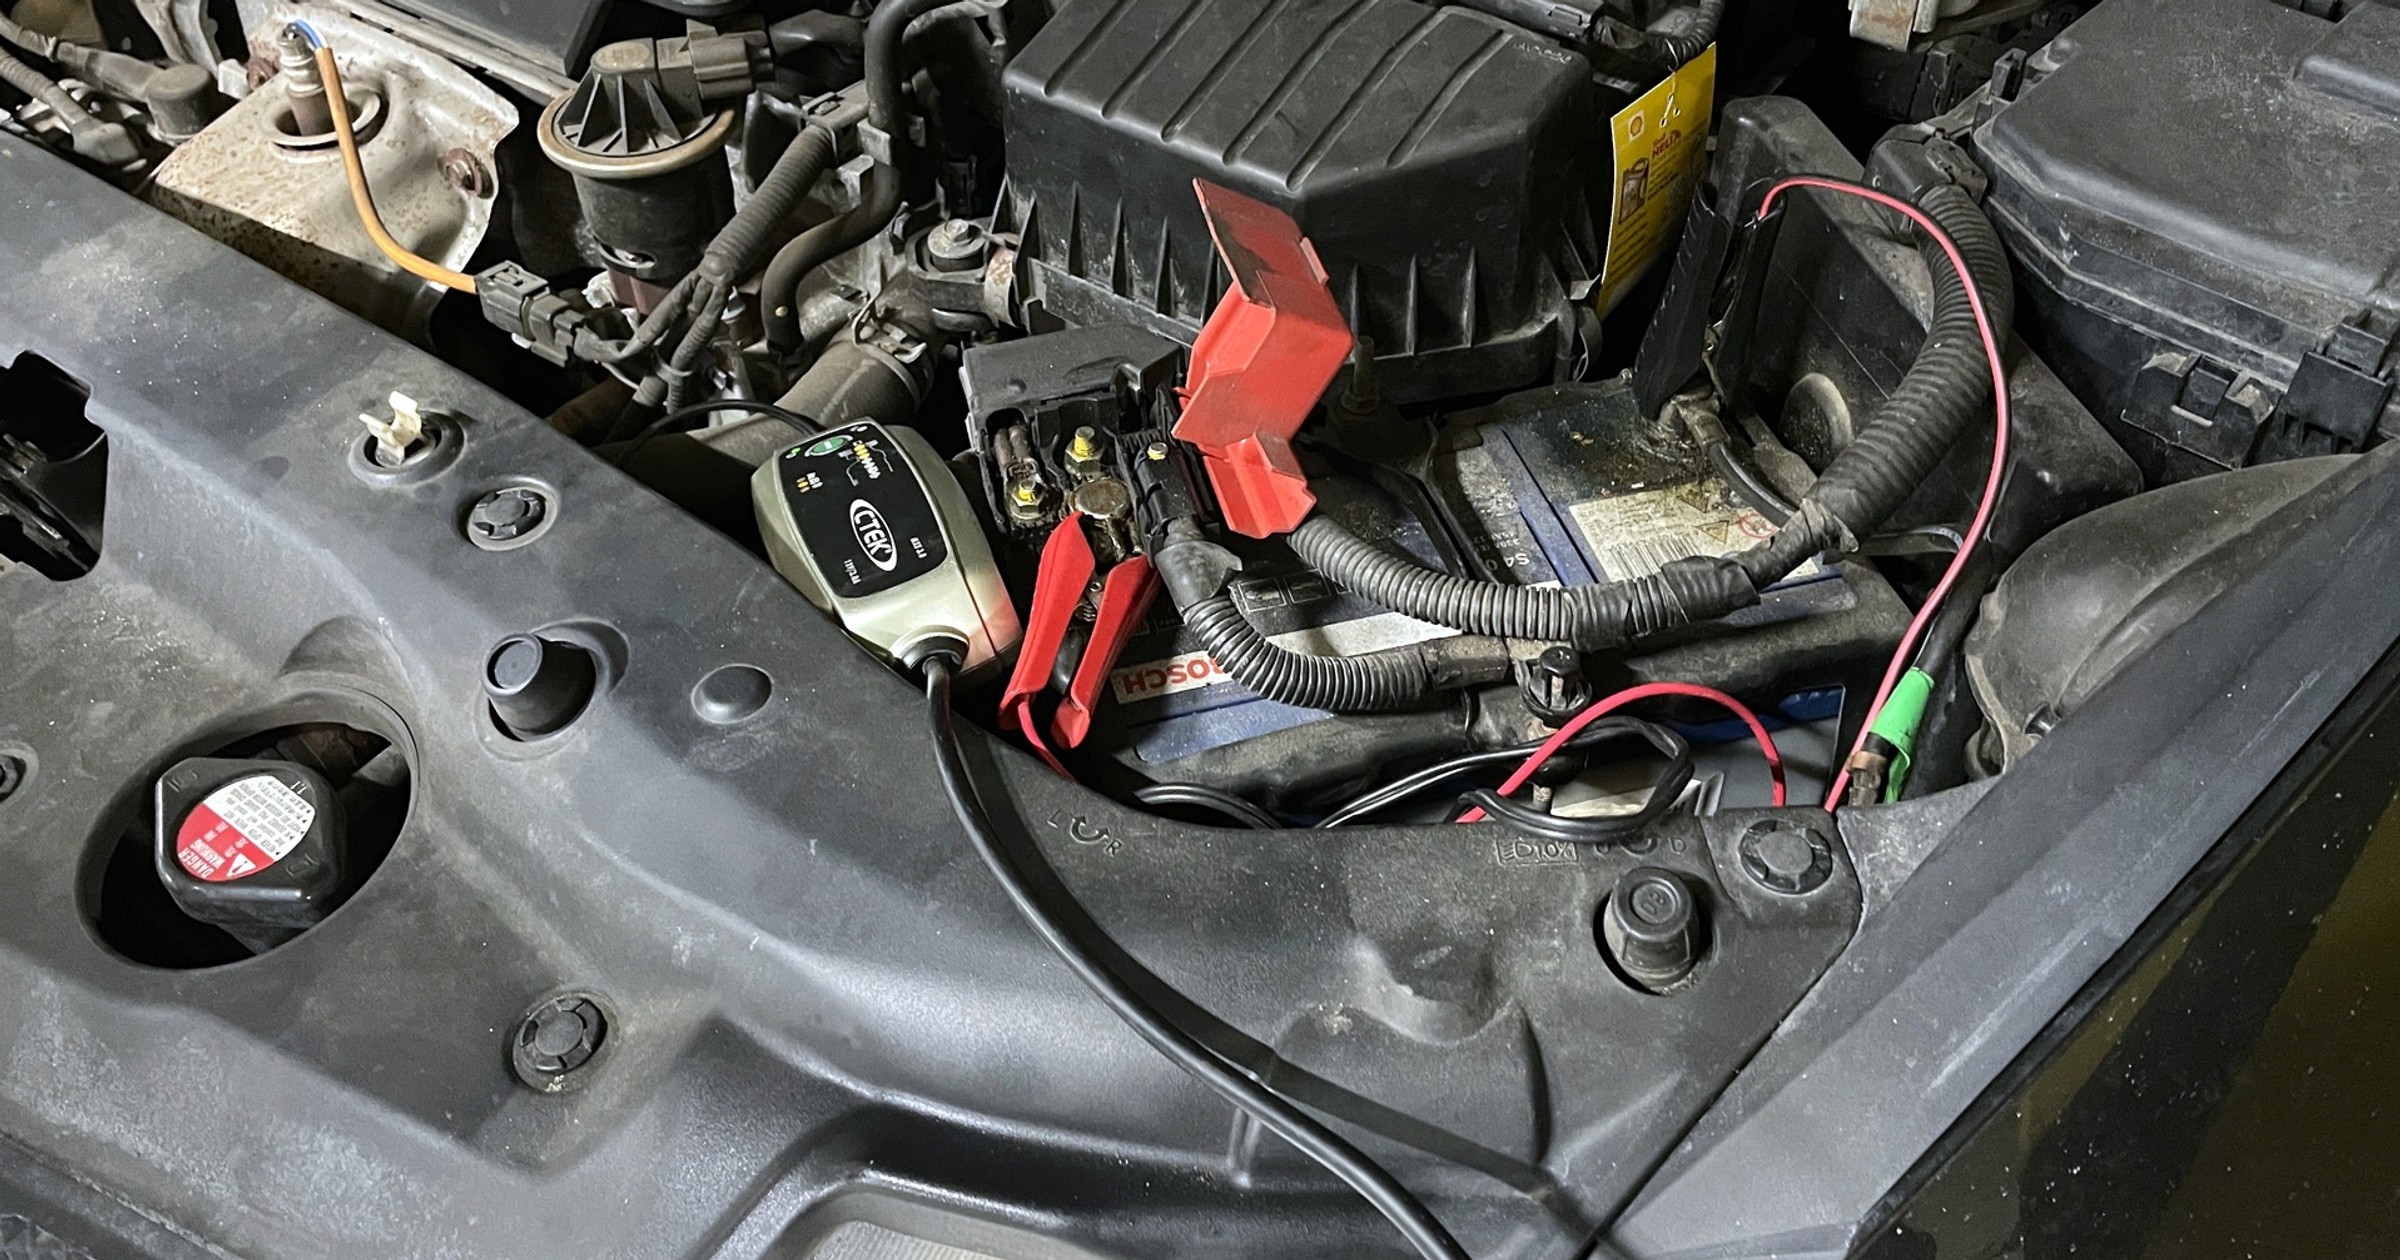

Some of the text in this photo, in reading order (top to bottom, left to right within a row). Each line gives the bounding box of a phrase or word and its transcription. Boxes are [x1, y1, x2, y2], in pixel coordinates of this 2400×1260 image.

[853, 508, 893, 556] CTEK
[178, 847, 215, 878] DANGER
[1106, 837, 1122, 857] R
